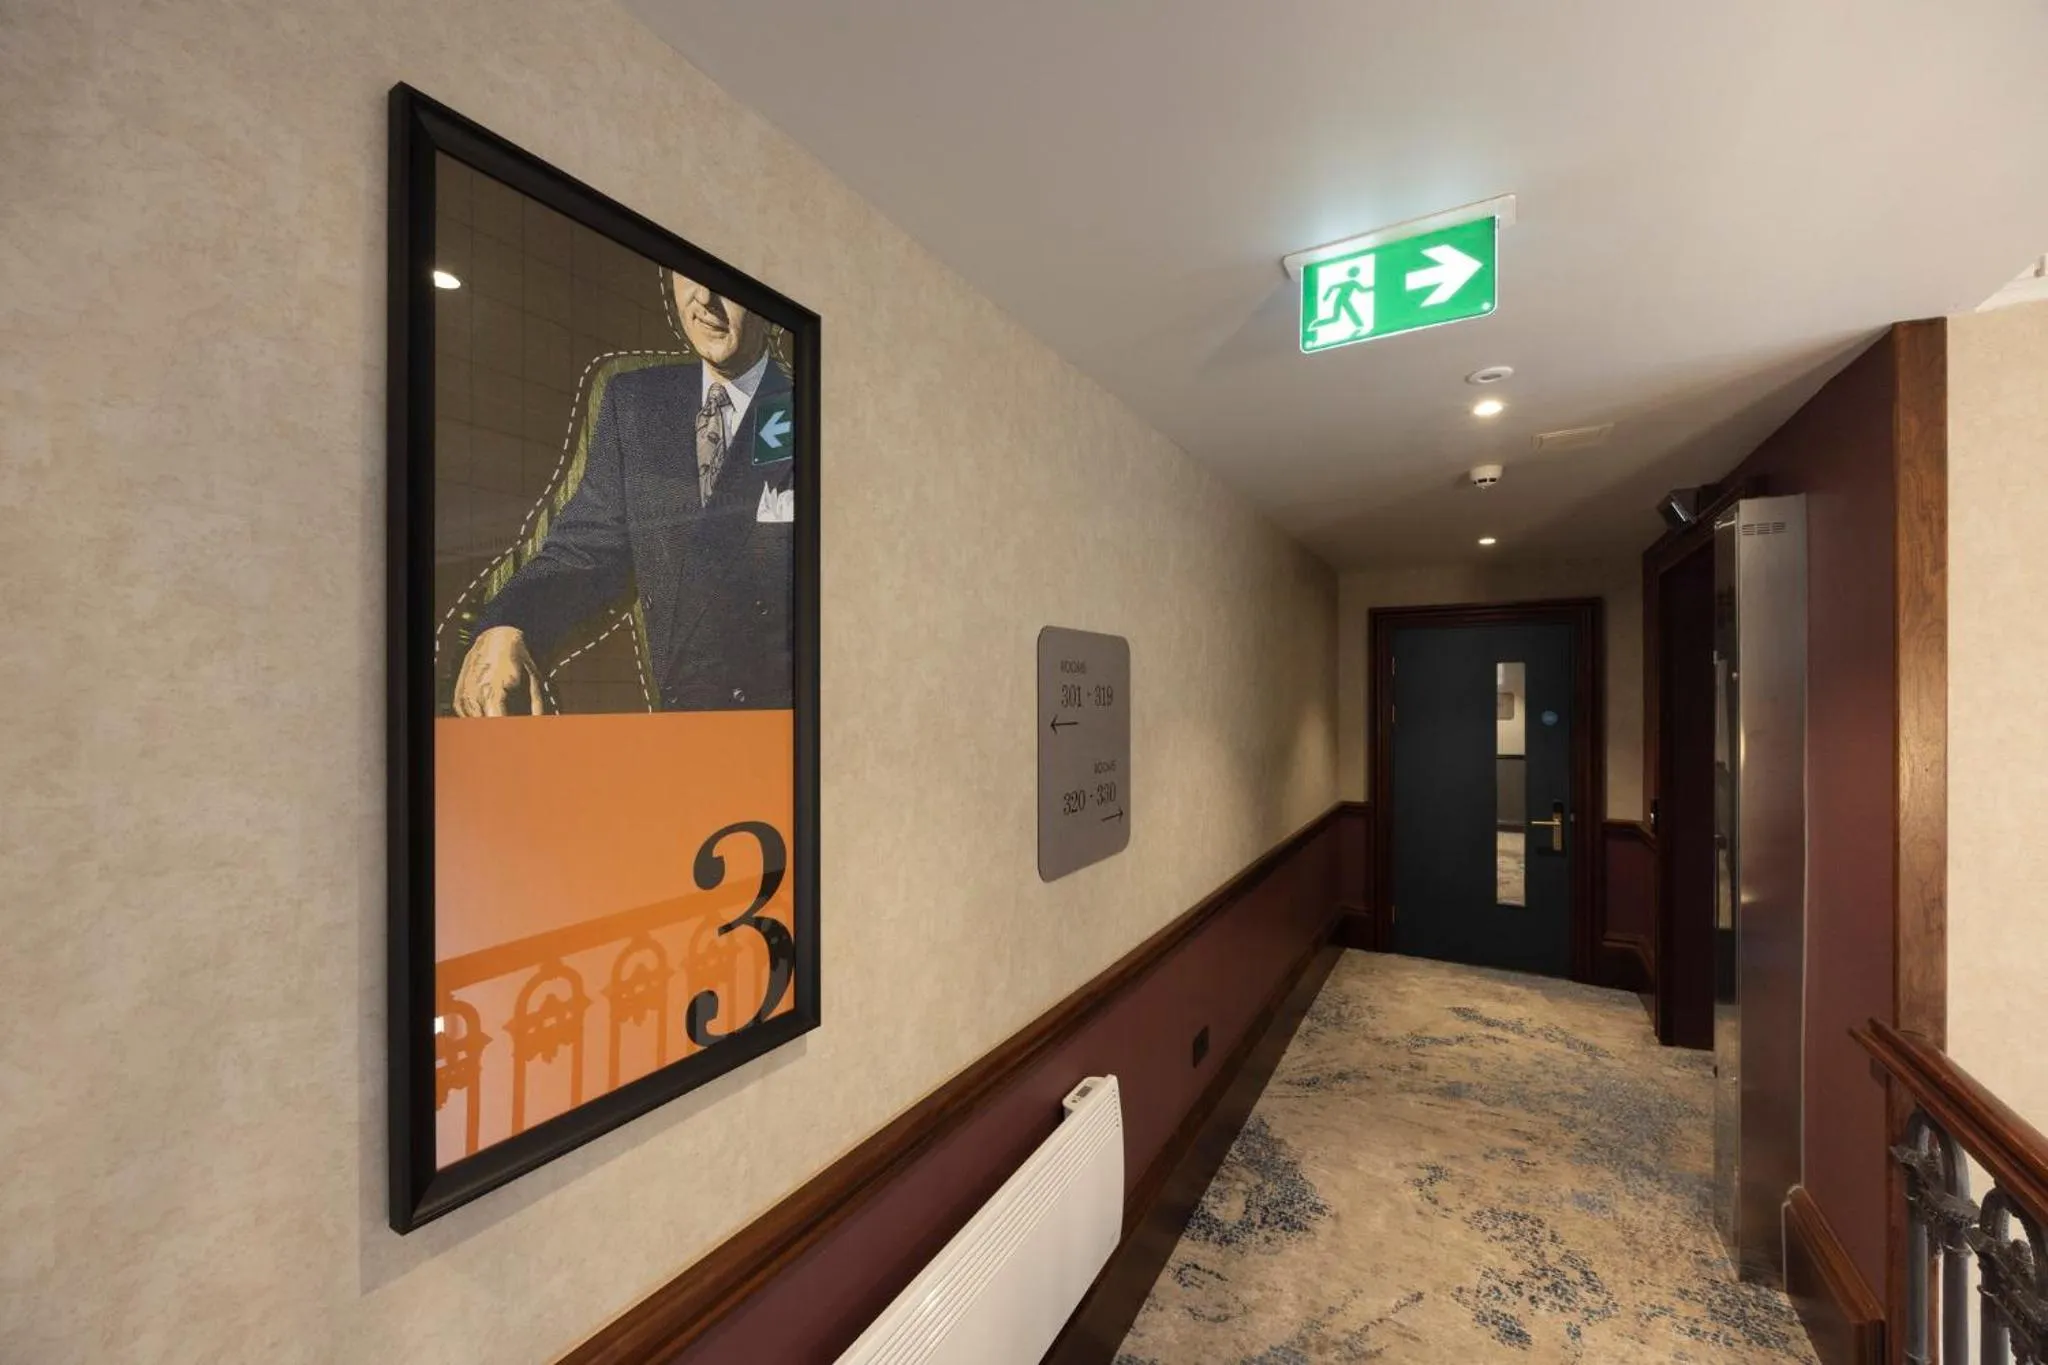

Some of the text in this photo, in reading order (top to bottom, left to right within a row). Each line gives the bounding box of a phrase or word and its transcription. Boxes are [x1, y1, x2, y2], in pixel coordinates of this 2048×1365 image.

[1061, 684, 1082, 708] 301
[1095, 684, 1113, 707] 319
[1063, 789, 1086, 815] 320
[686, 821, 794, 1047] 3
